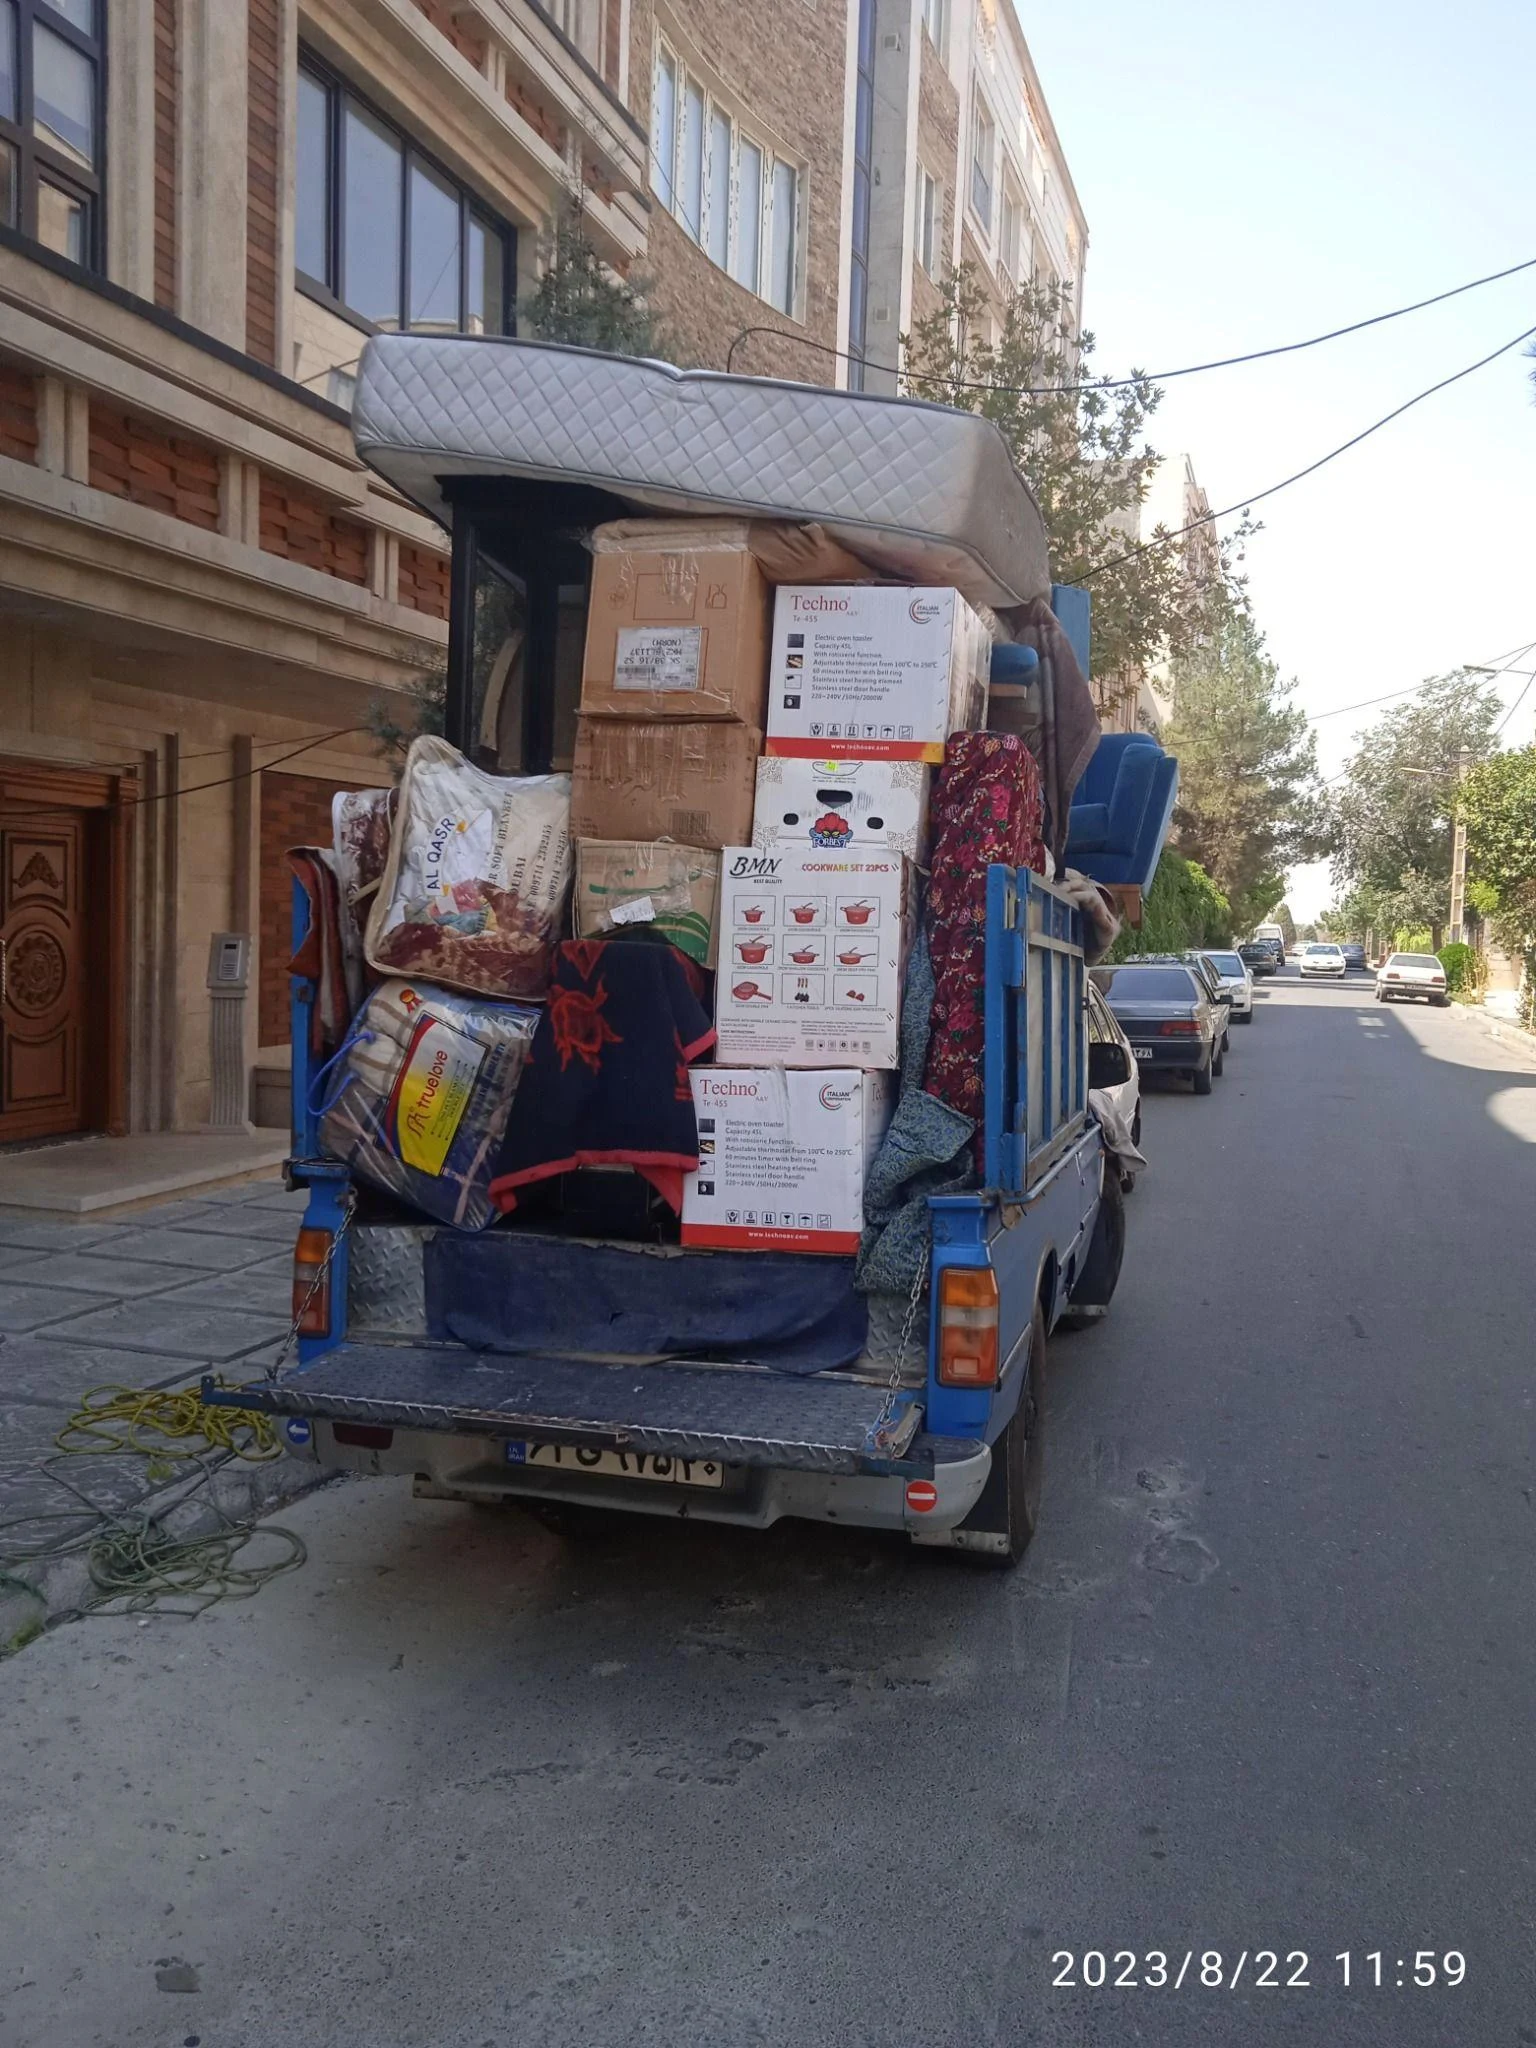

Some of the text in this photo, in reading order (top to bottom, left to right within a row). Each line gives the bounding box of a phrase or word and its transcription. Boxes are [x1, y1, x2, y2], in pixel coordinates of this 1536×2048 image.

[791, 595, 848, 611] Techno
[491, 844, 504, 869] SOFT
[498, 791, 514, 840] BLANKET
[426, 818, 455, 890] AL QASR
[729, 856, 782, 876] BMN
[802, 864, 848, 872] COOKWARE
[865, 864, 889, 872] 23PCS
[416, 1050, 448, 1109] truelove
[700, 1079, 757, 1096] Techno
